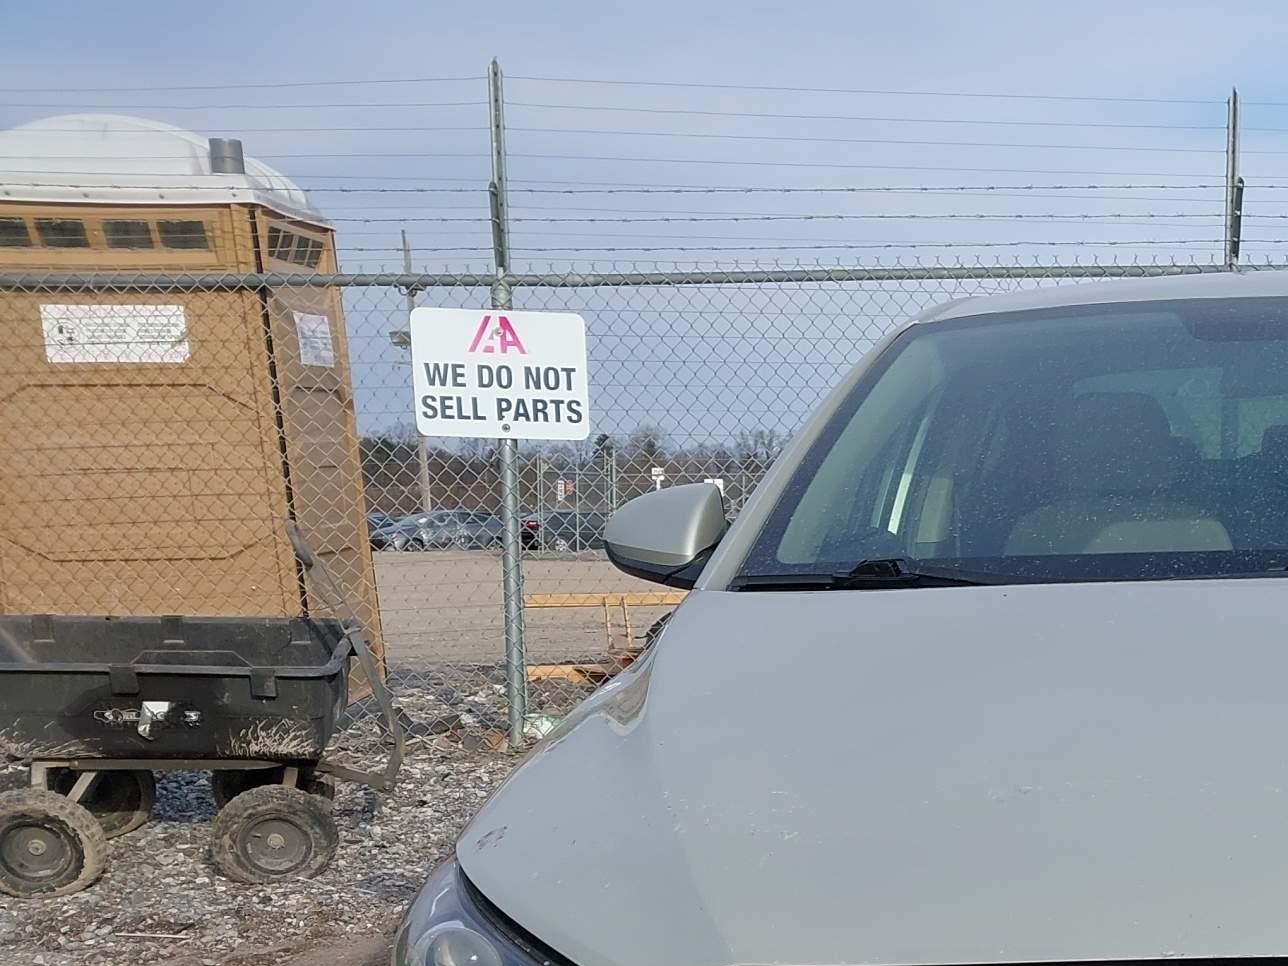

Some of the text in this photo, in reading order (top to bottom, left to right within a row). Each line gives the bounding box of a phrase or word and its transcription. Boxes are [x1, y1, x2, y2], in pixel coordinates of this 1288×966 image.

[424, 362, 577, 391] WE DO NOT
[421, 395, 583, 424] SELL PARTS
